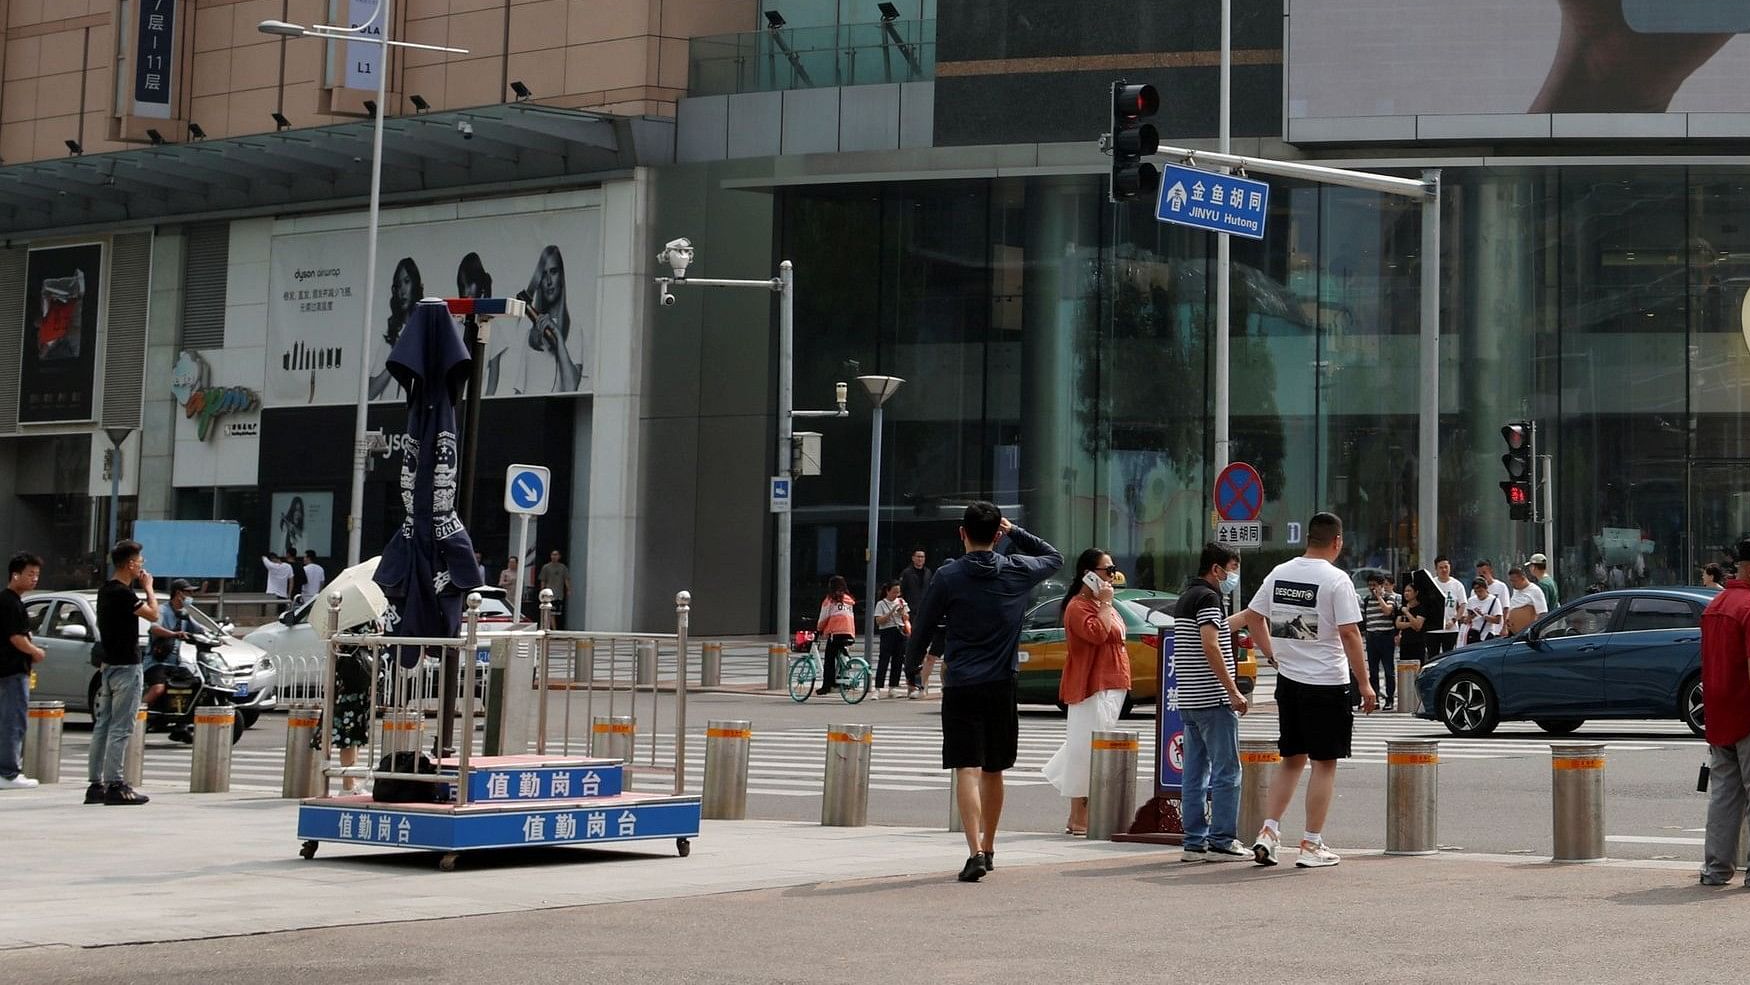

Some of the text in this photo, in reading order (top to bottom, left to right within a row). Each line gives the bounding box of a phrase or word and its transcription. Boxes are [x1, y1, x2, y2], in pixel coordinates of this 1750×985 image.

[357, 61, 372, 74] L1
[1191, 180, 1262, 212] 金鱼胡同
[1188, 206, 1258, 231] JINYU Hutong
[294, 267, 315, 282] dyson
[1219, 526, 1259, 543] 金鱼胡同
[486, 770, 602, 799] 值勤岗台
[338, 812, 412, 844] 值勤岗台
[522, 810, 637, 843] 值勤岗台
